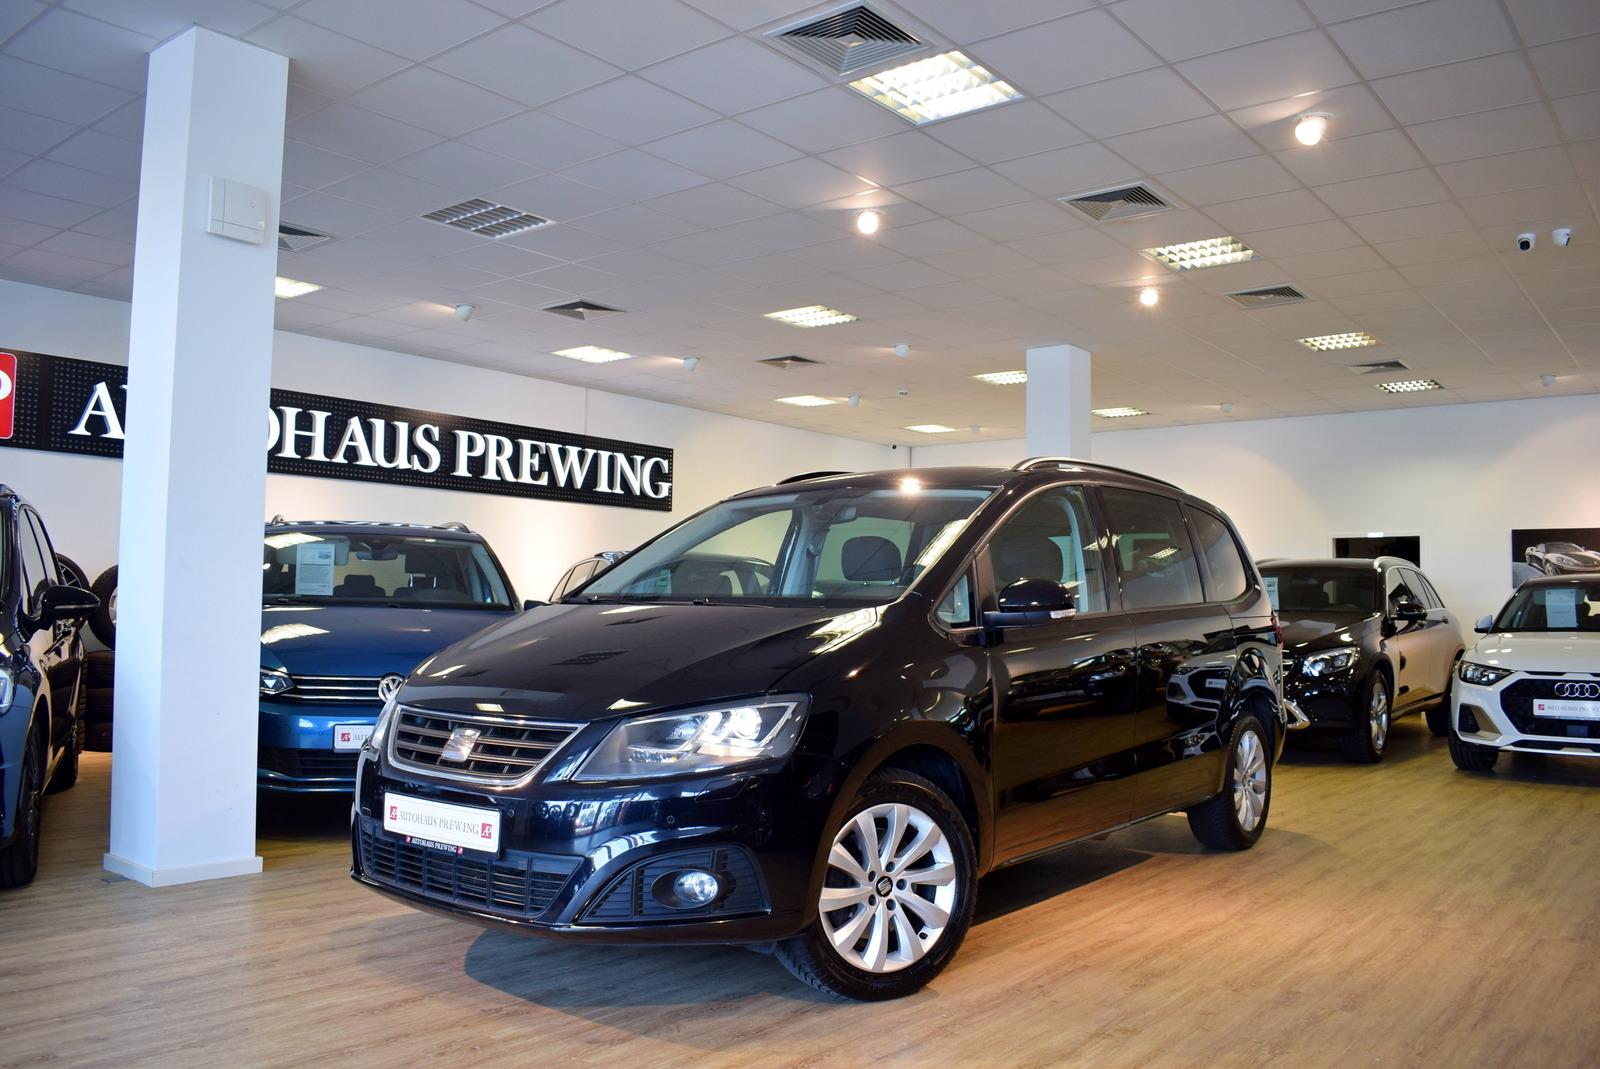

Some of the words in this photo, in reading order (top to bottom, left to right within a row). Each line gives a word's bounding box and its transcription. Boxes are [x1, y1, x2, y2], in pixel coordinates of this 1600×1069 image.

[450, 429, 673, 499] PREWING
[399, 809, 438, 827] AUTOHAUS
[438, 817, 479, 835] PREWING
